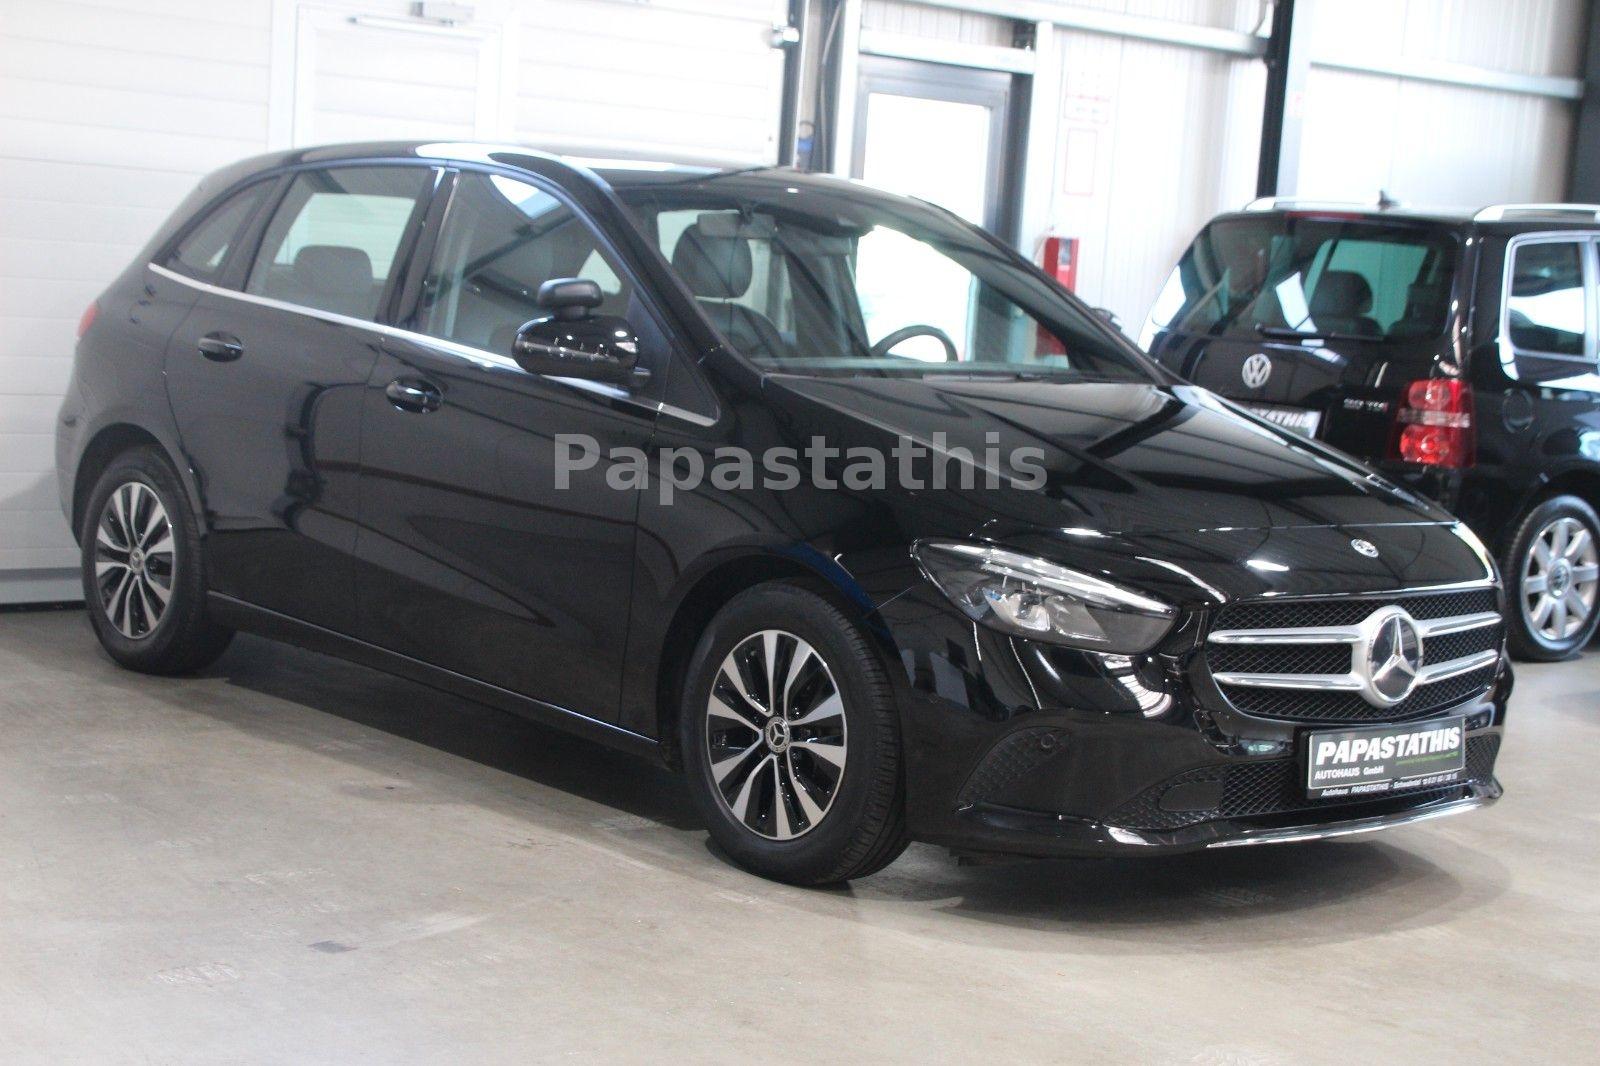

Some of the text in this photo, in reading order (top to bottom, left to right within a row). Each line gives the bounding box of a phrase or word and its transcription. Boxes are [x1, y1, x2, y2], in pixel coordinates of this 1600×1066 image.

[1315, 726, 1461, 766] PAPASTATHIS
[1314, 765, 1385, 780] AUTOHAUS GmbH
